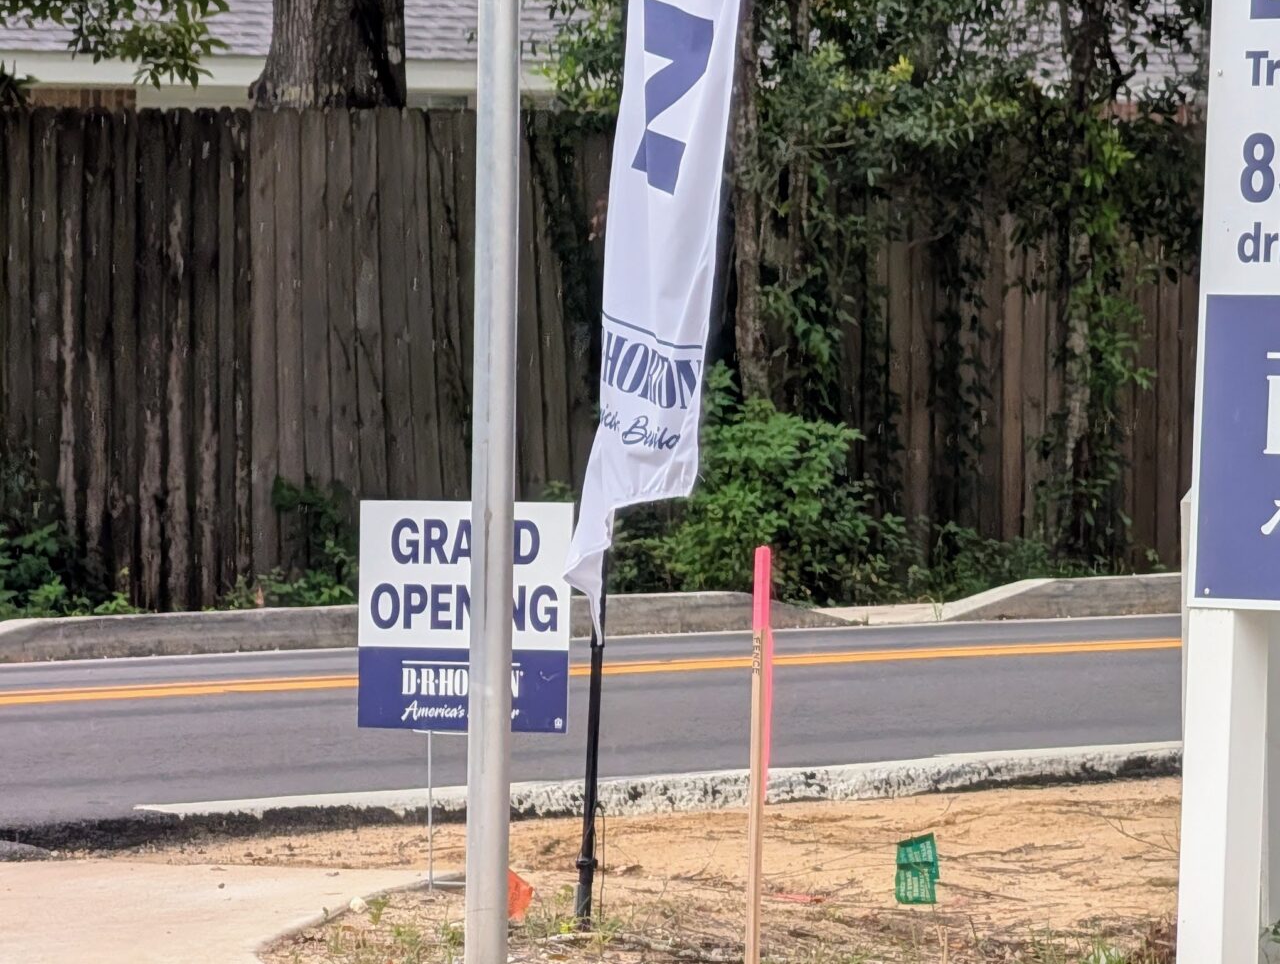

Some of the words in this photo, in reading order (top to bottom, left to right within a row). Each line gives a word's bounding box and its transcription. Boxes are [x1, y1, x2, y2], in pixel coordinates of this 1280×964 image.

[391, 518, 540, 565] GRAD
[370, 583, 558, 632] OPENNG
[401, 700, 465, 721] America's
